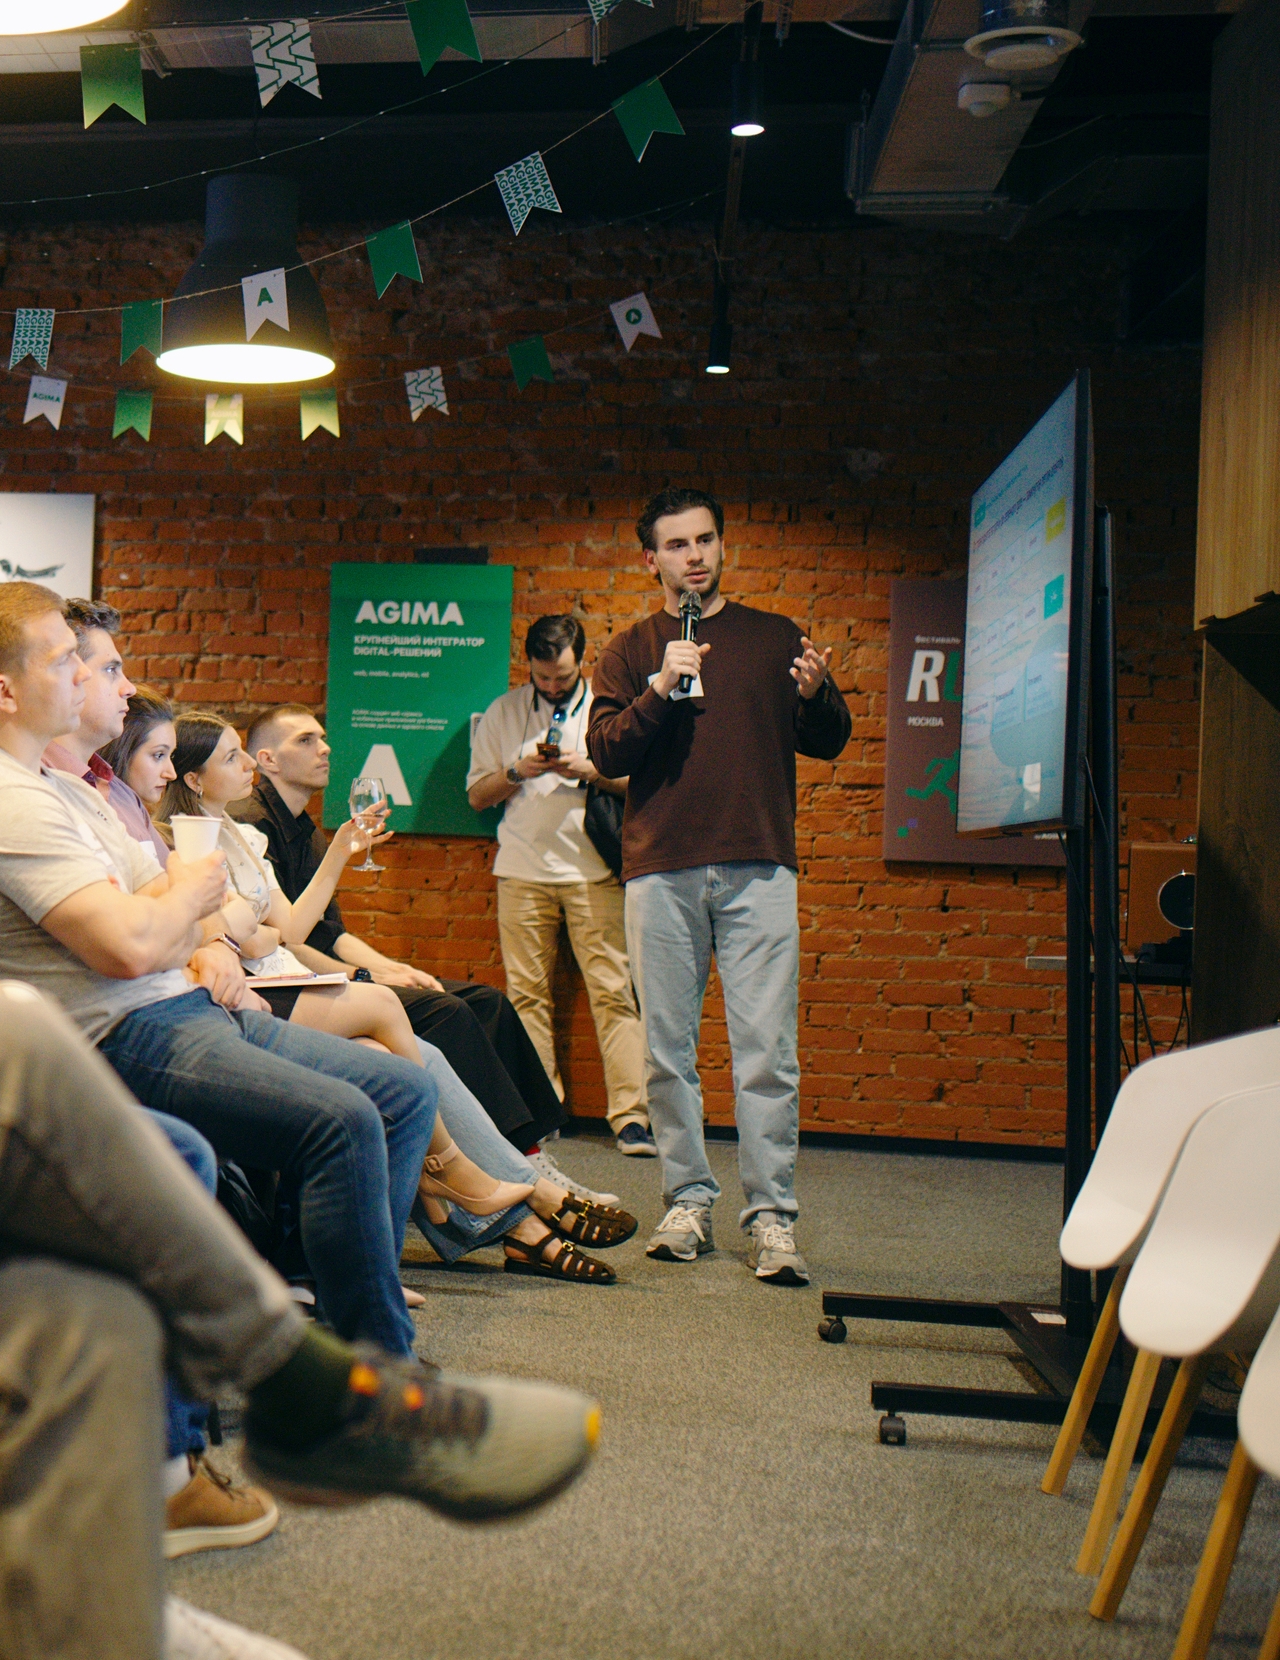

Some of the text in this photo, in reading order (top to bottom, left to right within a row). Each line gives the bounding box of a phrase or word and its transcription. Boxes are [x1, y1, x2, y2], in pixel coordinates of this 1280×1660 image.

[257, 287, 274, 307] A
[355, 600, 464, 626] AGIMA
[354, 635, 485, 647] КРУПНЕЙШИЙ ИНТЕГРАТОР
[353, 646, 442, 657] DIGITAL-РЕШЕНИЙ
[907, 716, 944, 727] МОСКВА
[353, 744, 413, 806] A
